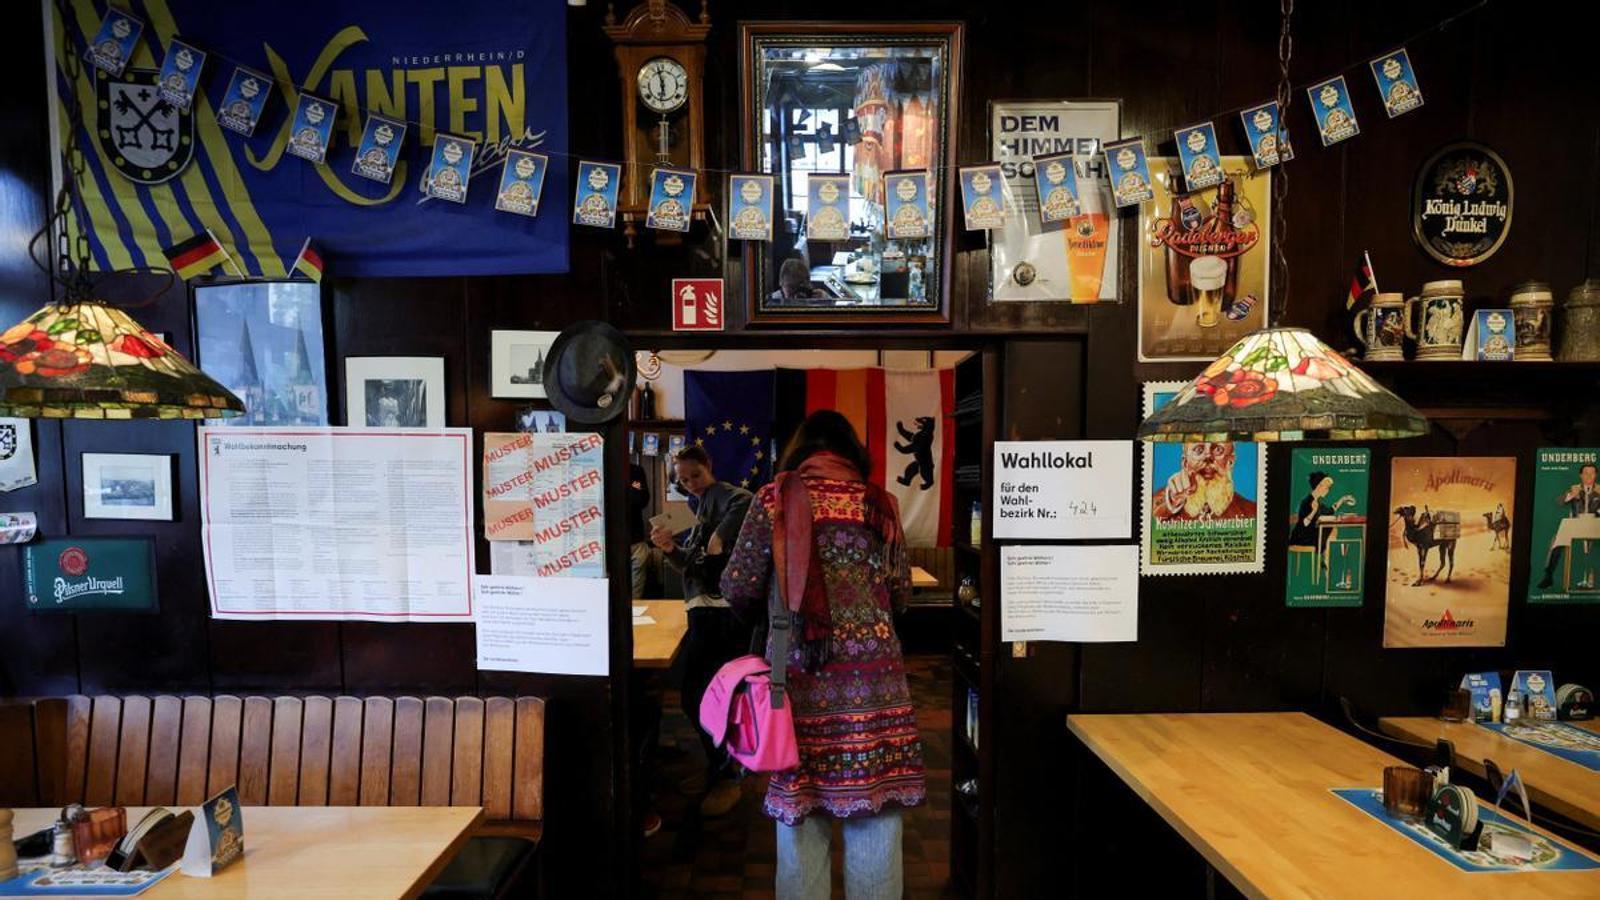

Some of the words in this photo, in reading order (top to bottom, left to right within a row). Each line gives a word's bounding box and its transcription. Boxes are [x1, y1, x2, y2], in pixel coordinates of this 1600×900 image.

[392, 51, 525, 65] NIEDERRHEIN/D
[1001, 116, 1059, 132] DEM
[1001, 138, 1105, 155] HIMMEL
[1422, 199, 1461, 219] König
[1460, 201, 1507, 221] Ludwig
[1151, 219, 1258, 249] Radeberger
[1441, 216, 1487, 237] Dunkel
[484, 434, 533, 464] MUSTER
[534, 434, 602, 472] MUSTER
[1541, 453, 1597, 462] UNDERBERG
[1001, 452, 1093, 468] Wahllokal
[486, 470, 533, 498] MUSTER
[534, 470, 602, 509] MUSTER
[1000, 482, 1015, 493] für
[1018, 483, 1039, 493] den
[1000, 495, 1032, 506] Wahl-
[1069, 501, 1097, 515] 424
[488, 507, 533, 535] MUSTER
[1000, 508, 1034, 519] bezirk
[1037, 508, 1057, 519] Nr.:
[1199, 512, 1254, 530] Schwarzbier
[535, 506, 602, 544] MUSTER
[537, 541, 602, 576] MUSTER
[53, 577, 88, 603] Pilsner
[87, 576, 123, 595] Urquell
